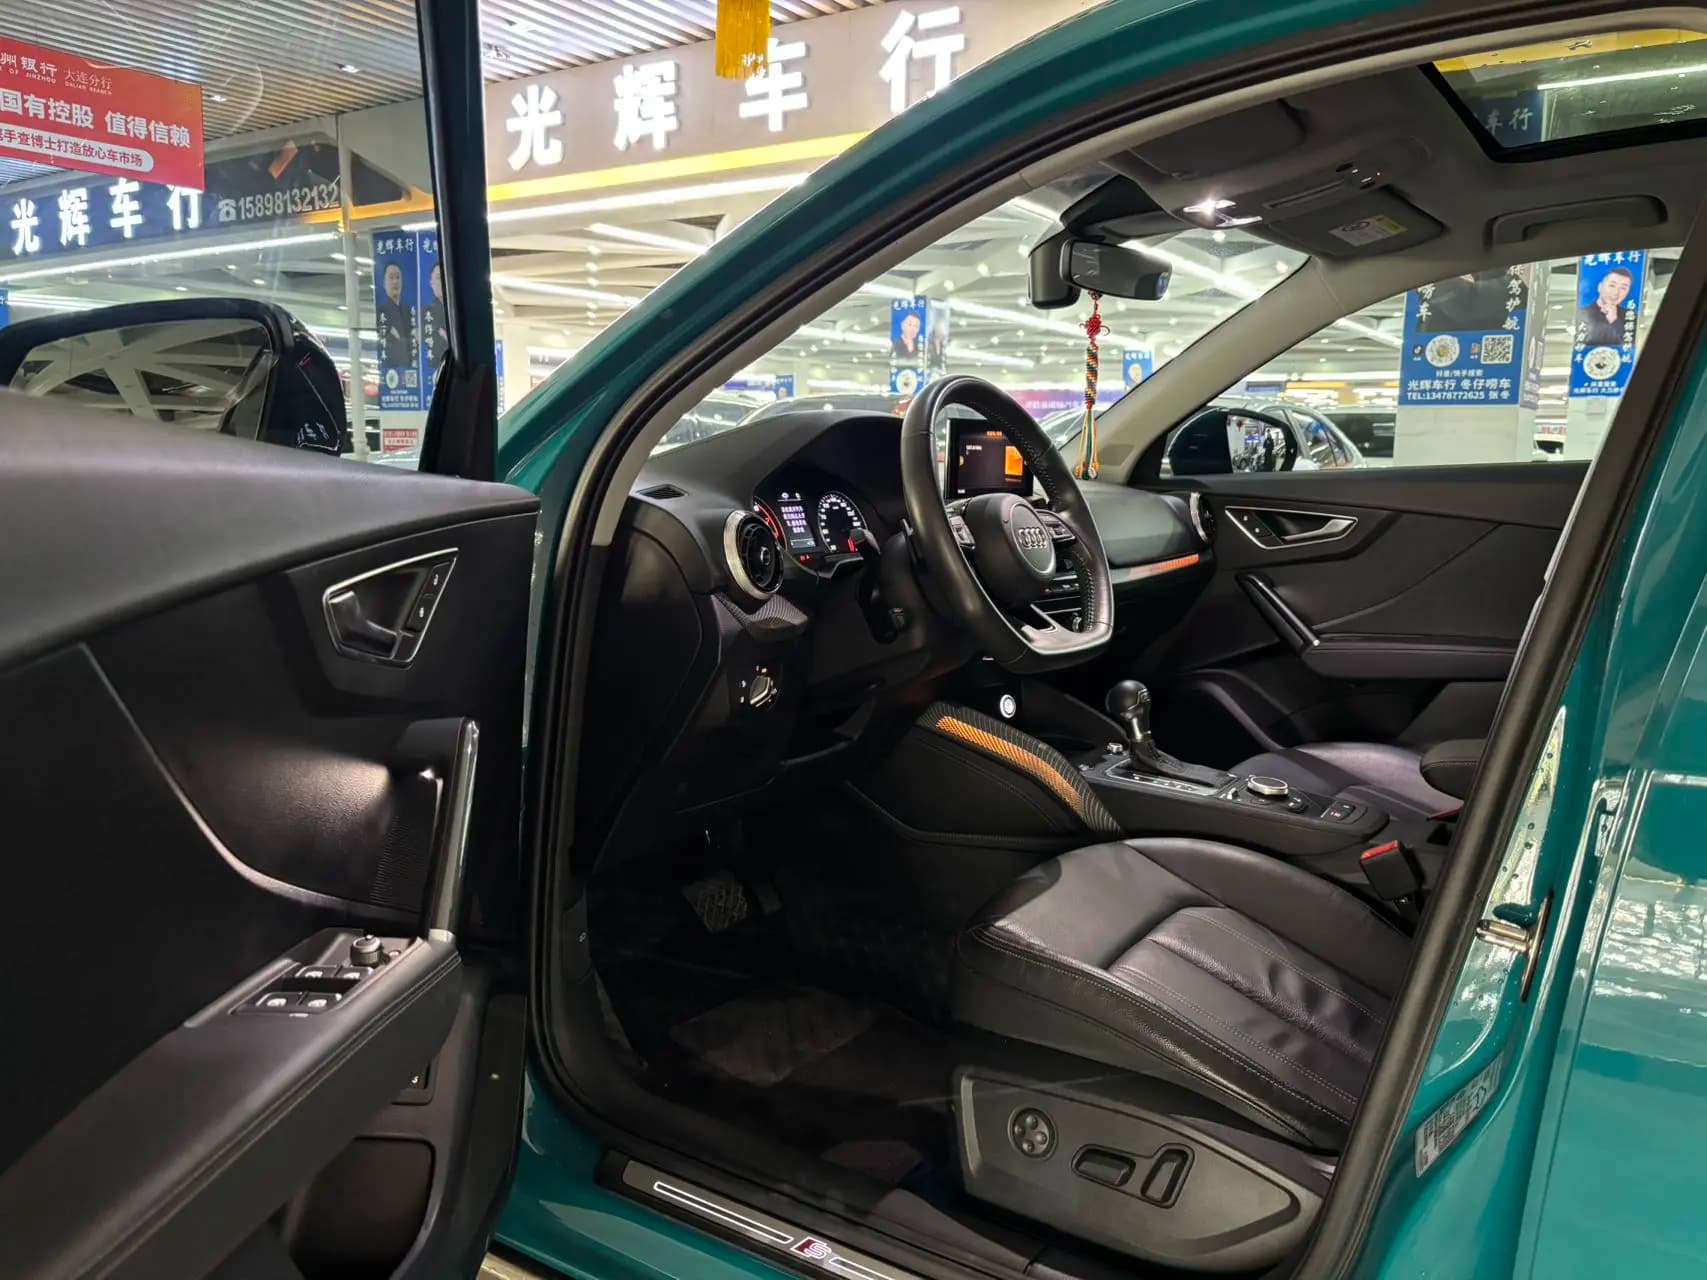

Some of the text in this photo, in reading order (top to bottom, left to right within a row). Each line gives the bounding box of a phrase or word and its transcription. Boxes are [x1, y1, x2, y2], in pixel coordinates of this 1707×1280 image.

[64, 68, 113, 90] 大连分行
[506, 6, 965, 170] 光辉车行
[0, 87, 191, 148] 国有控股 值得信赖
[0, 127, 143, 167] 手查博士打造放心车市场
[10, 177, 204, 256] 光辉车行
[238, 184, 339, 219] 15898132132
[1408, 379, 1457, 391] 光辉车行
